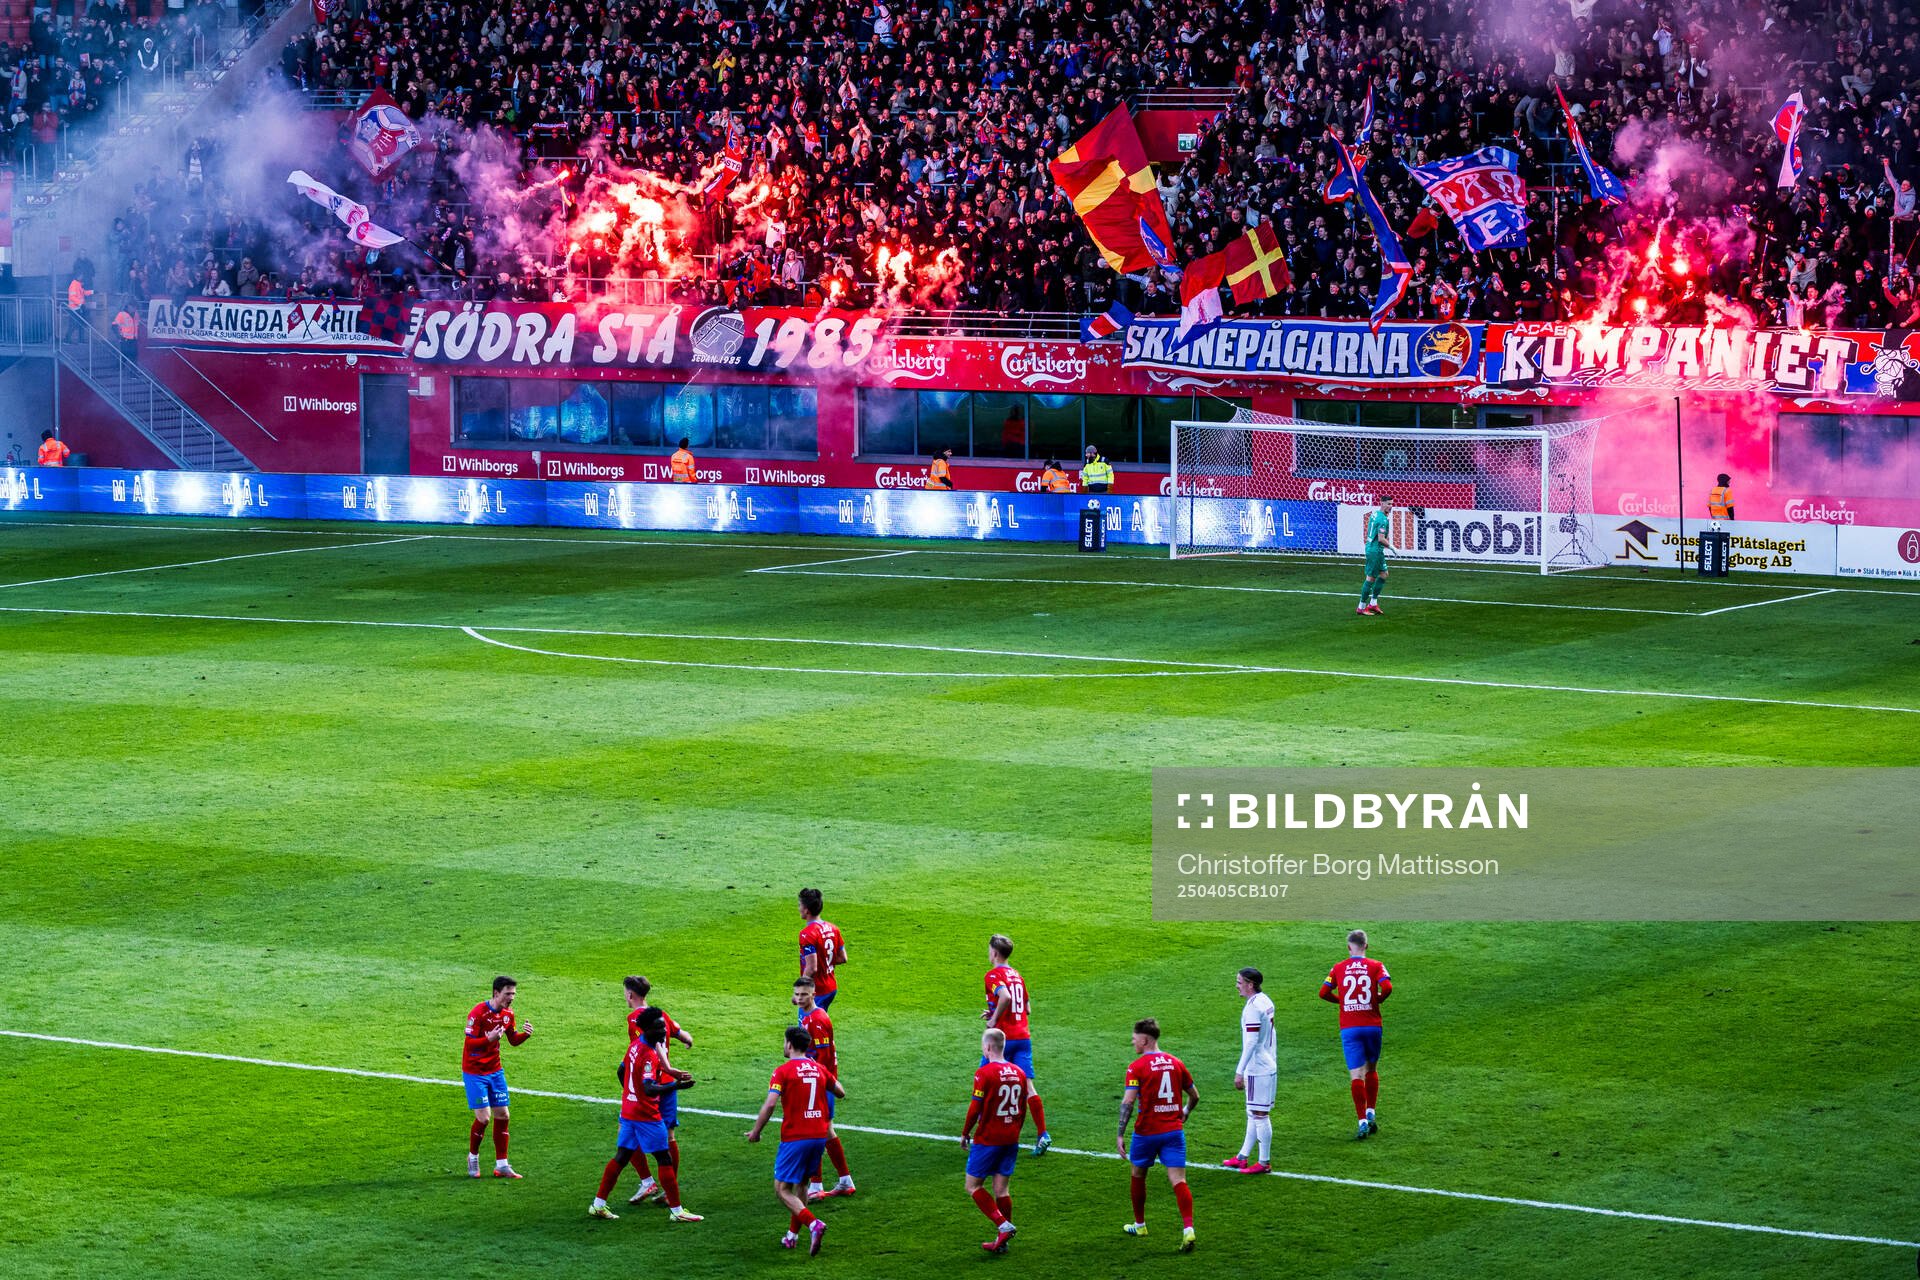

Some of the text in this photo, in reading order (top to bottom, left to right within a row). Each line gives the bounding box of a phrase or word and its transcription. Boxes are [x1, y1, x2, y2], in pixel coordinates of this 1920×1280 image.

[153, 303, 283, 331] AVSTÄNGDA
[1514, 322, 1567, 336] ACAB
[413, 302, 577, 365] SÖDRA
[592, 303, 684, 364] STÅ
[749, 317, 883, 369] 1985
[1001, 345, 1087, 379] Carlsberg
[299, 397, 357, 414] Wihlborgs
[459, 458, 518, 475] Wihlborgs
[564, 462, 625, 480] Wihlborgs
[660, 466, 722, 480] Worgs
[762, 469, 825, 487] Wihlborgs
[876, 467, 929, 488] Carlsber
[343, 481, 392, 509] MÅL
[459, 484, 506, 513] MÅL
[585, 488, 635, 516] MÅL
[707, 491, 756, 520] MÅL
[1308, 482, 1373, 505] Carlsberg
[839, 495, 892, 524] MÅL
[967, 498, 1019, 528] MÅL
[1106, 502, 1162, 531] MÅL
[1785, 499, 1855, 525] Carlsberg
[1084, 518, 1093, 548] SELECT
[1730, 536, 1805, 554] Plåtslageri
[1704, 540, 1713, 571] SELECT
[1771, 556, 1792, 567] AB
[1010, 983, 1024, 1013] 19
[1343, 975, 1372, 1004] 23
[803, 1077, 817, 1110] 7
[997, 1084, 1022, 1116] 29
[1158, 1071, 1174, 1103] 4
